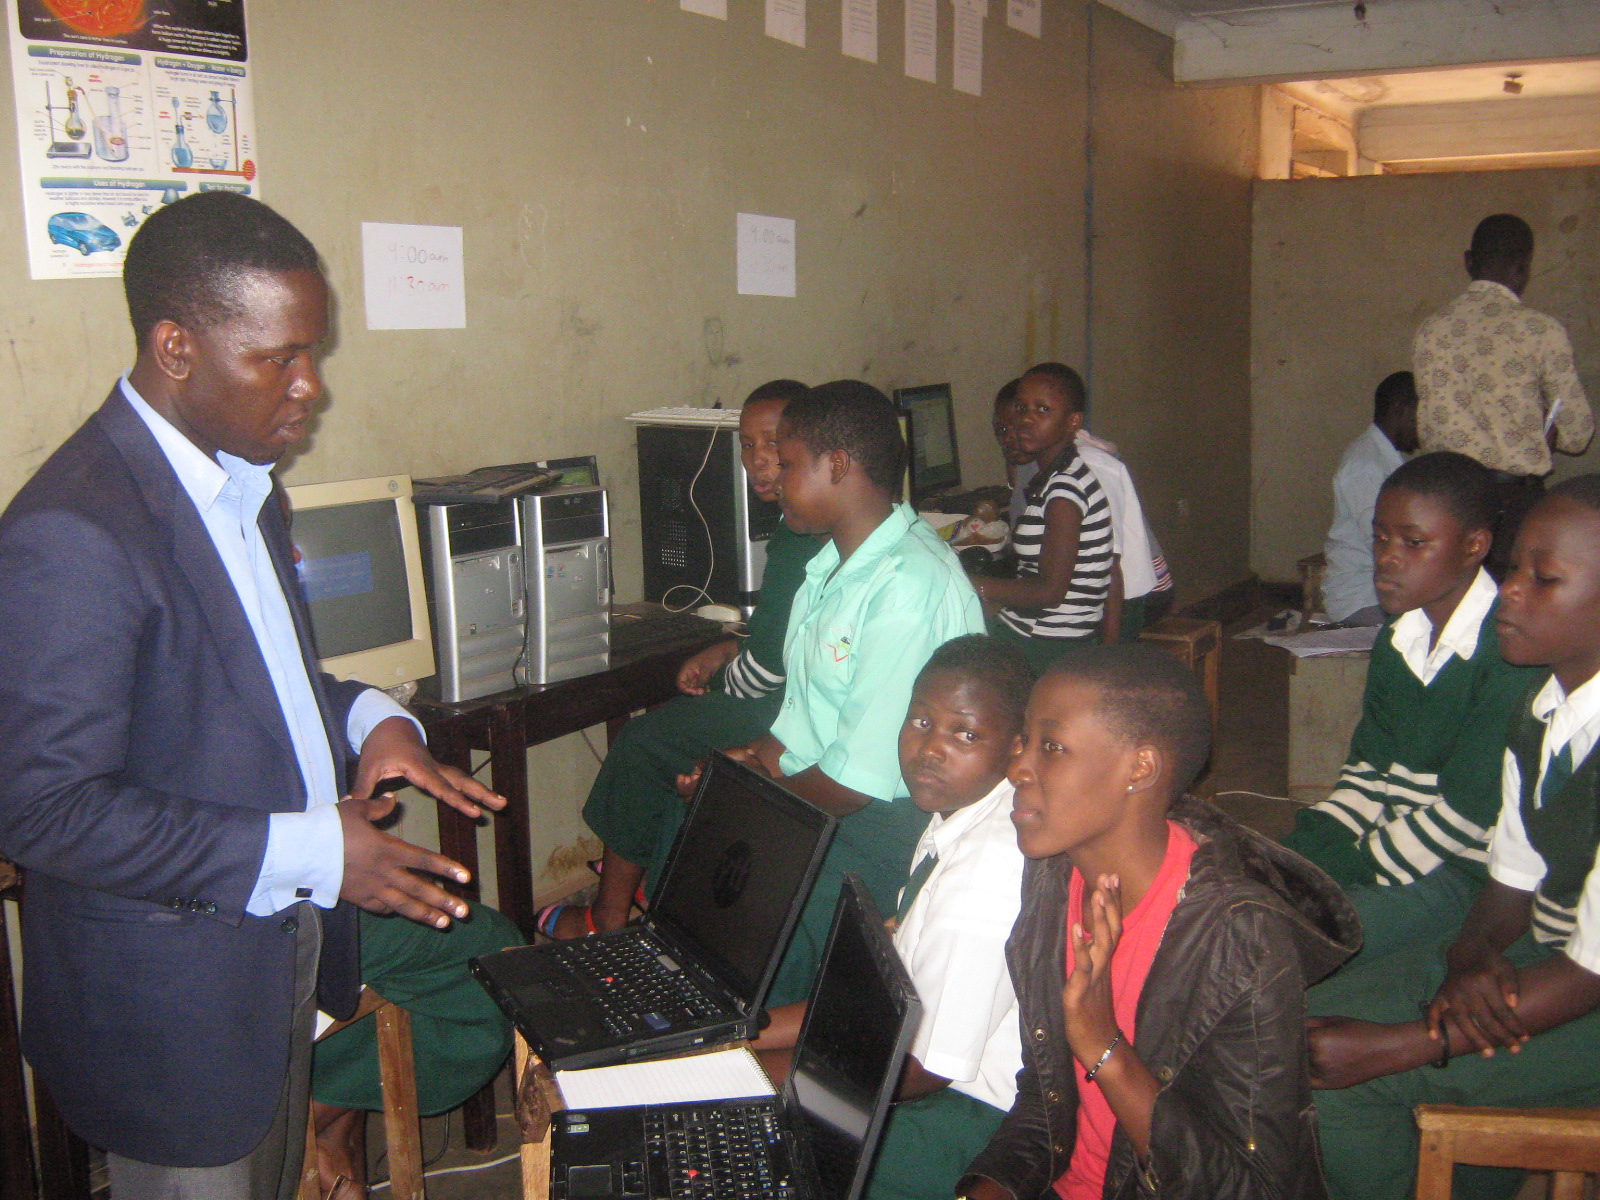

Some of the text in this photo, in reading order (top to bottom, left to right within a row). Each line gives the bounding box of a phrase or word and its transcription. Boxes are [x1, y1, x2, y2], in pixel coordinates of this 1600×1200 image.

[49, 48, 87, 59] Preparation
[96, 52, 125, 62] Hydrogen
[157, 59, 182, 68] Hydrogen
[186, 61, 206, 70] Oxygen
[117, 181, 146, 189] Hydrogen
